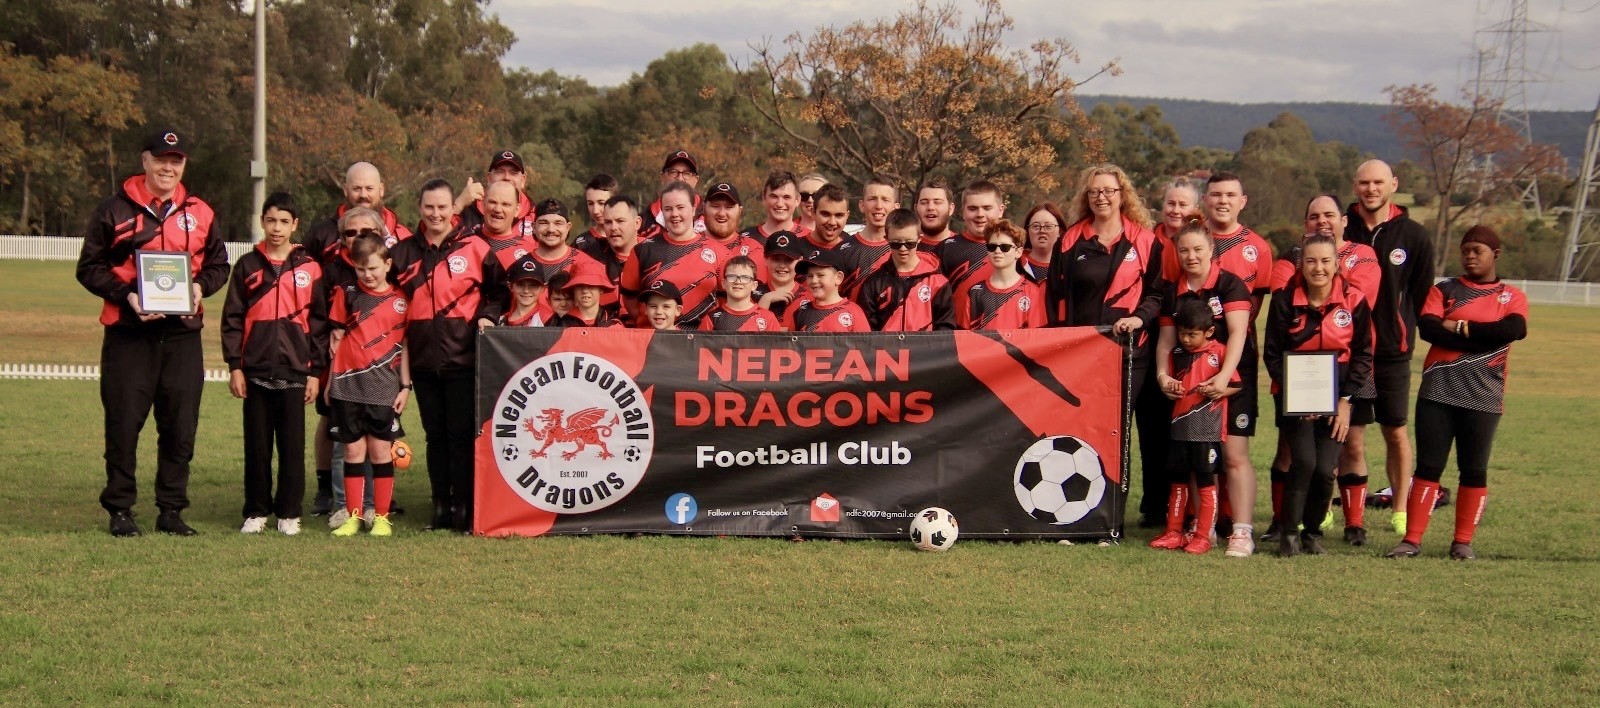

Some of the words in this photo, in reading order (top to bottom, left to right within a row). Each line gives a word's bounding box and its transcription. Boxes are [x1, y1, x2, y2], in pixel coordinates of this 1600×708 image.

[697, 347, 910, 382] NEPEAN
[495, 360, 566, 438] Nepean
[572, 356, 650, 440] Football
[674, 390, 935, 428] DRAGONS
[696, 441, 828, 469] Football
[837, 440, 912, 465] Club
[516, 465, 626, 509] Dragons
[559, 470, 571, 478] Est.
[572, 470, 589, 478] 2007
[707, 508, 731, 517] Follow
[752, 508, 789, 516] Facebook
[846, 508, 919, 520] ndfc2007@gmail.co
